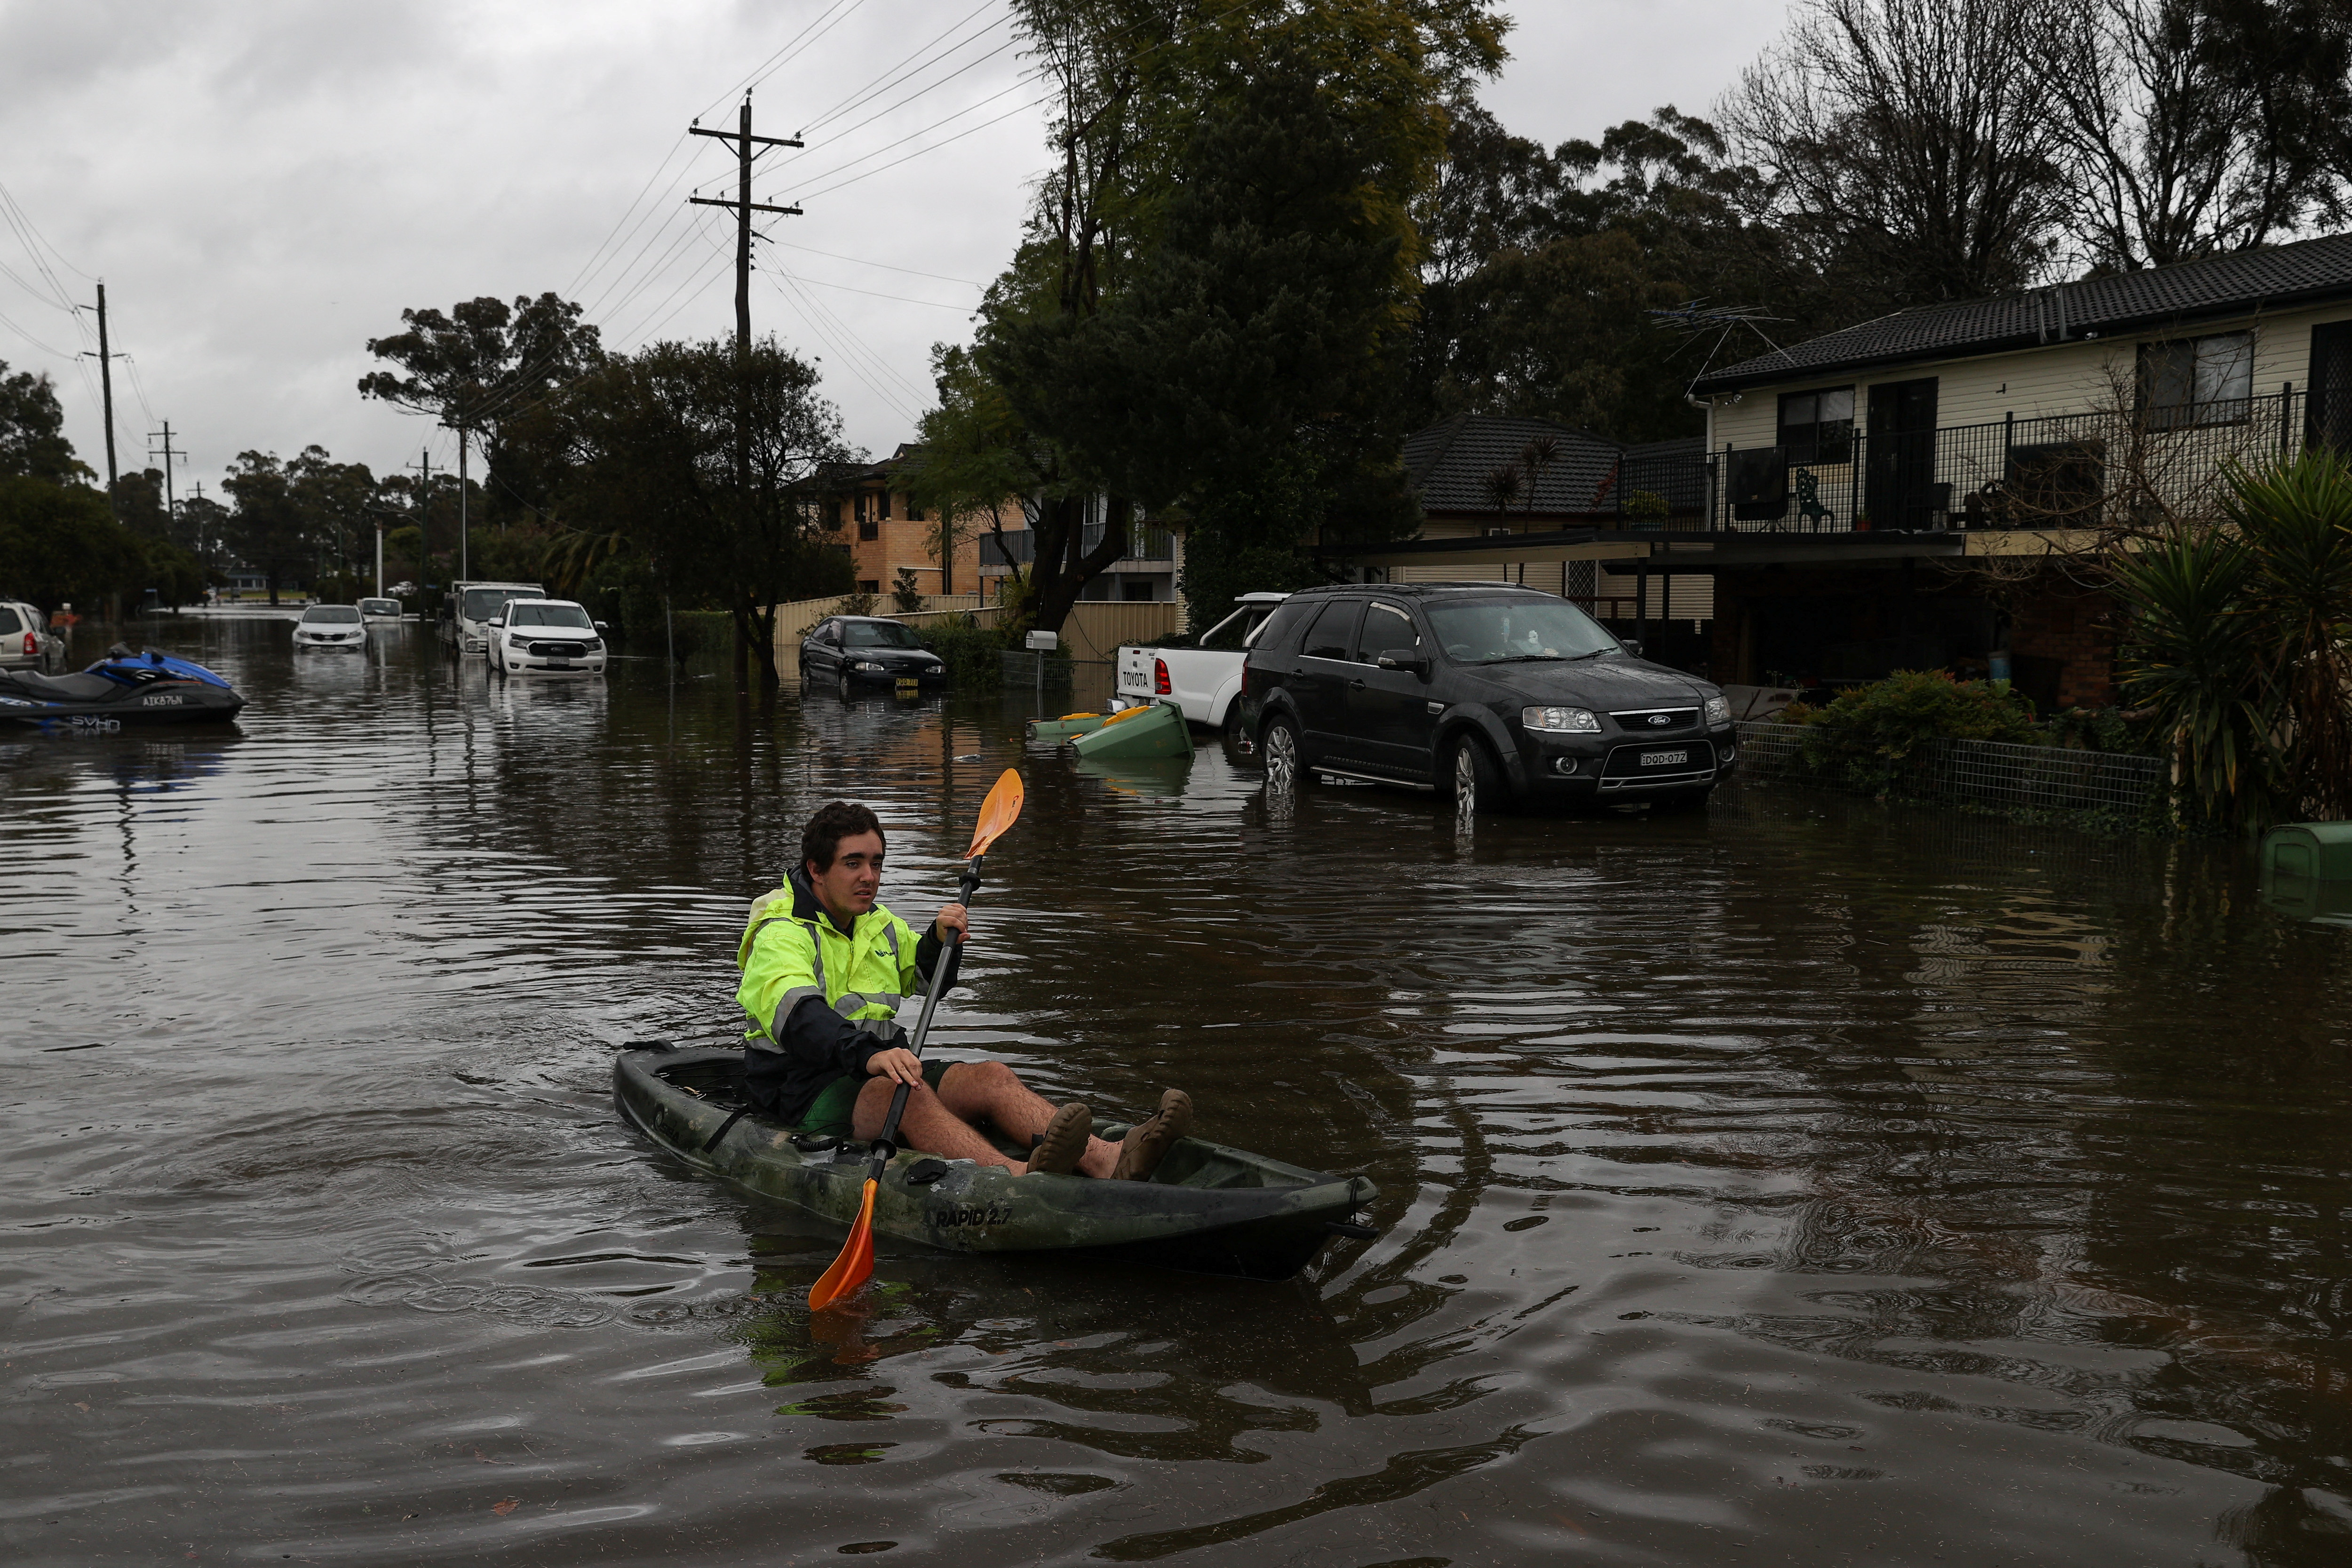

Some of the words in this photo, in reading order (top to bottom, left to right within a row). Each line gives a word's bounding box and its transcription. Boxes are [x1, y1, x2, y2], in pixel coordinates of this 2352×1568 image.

[1123, 671, 1148, 687] TOYOTA
[936, 1209, 985, 1227] RAPID
[987, 1208, 1013, 1225] 2.7
